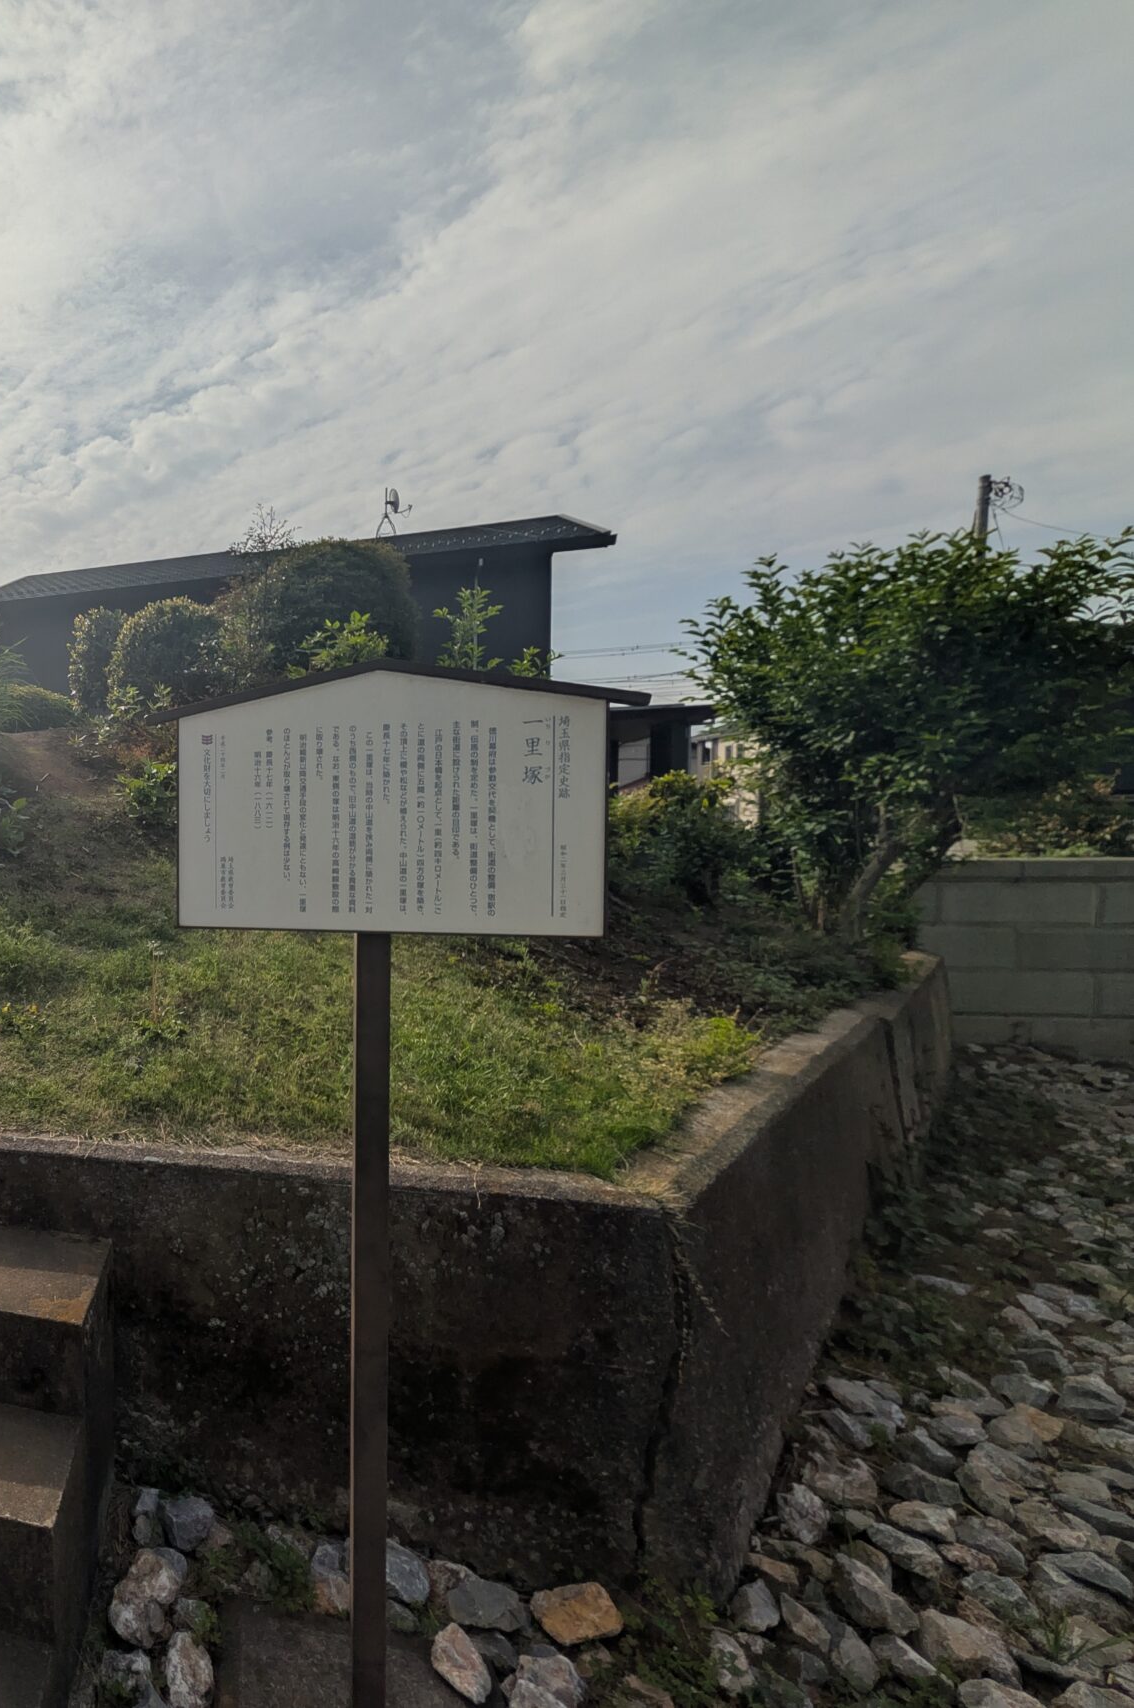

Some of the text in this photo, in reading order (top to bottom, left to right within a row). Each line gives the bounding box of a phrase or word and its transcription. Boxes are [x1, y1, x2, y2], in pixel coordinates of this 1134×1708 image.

[522, 719, 543, 785] 一里塚
[558, 715, 571, 799] 埼玉県指定史跡
[203, 749, 211, 842] 文化財を大切にしましょう
